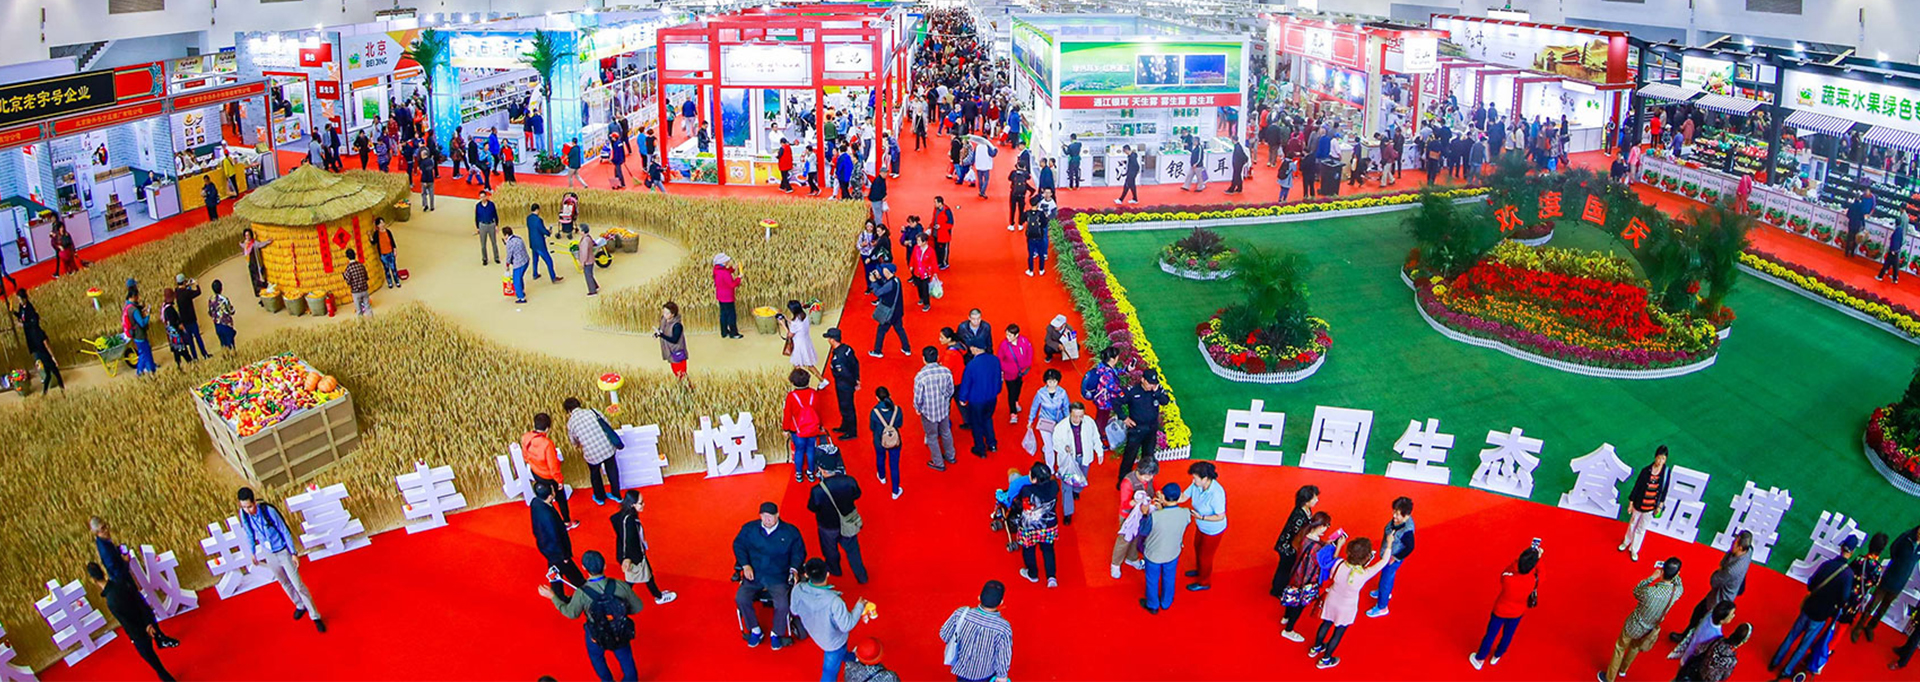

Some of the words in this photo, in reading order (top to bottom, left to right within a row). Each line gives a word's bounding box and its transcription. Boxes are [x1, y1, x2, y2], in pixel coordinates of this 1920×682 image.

[365, 40, 386, 58] 北京
[0, 85, 91, 114] 北京老字号企业
[1093, 97, 1129, 107] 通江银耳
[1165, 159, 1186, 179] 银
[1213, 157, 1229, 176] 耳
[1494, 190, 1651, 249] 欢度国庆
